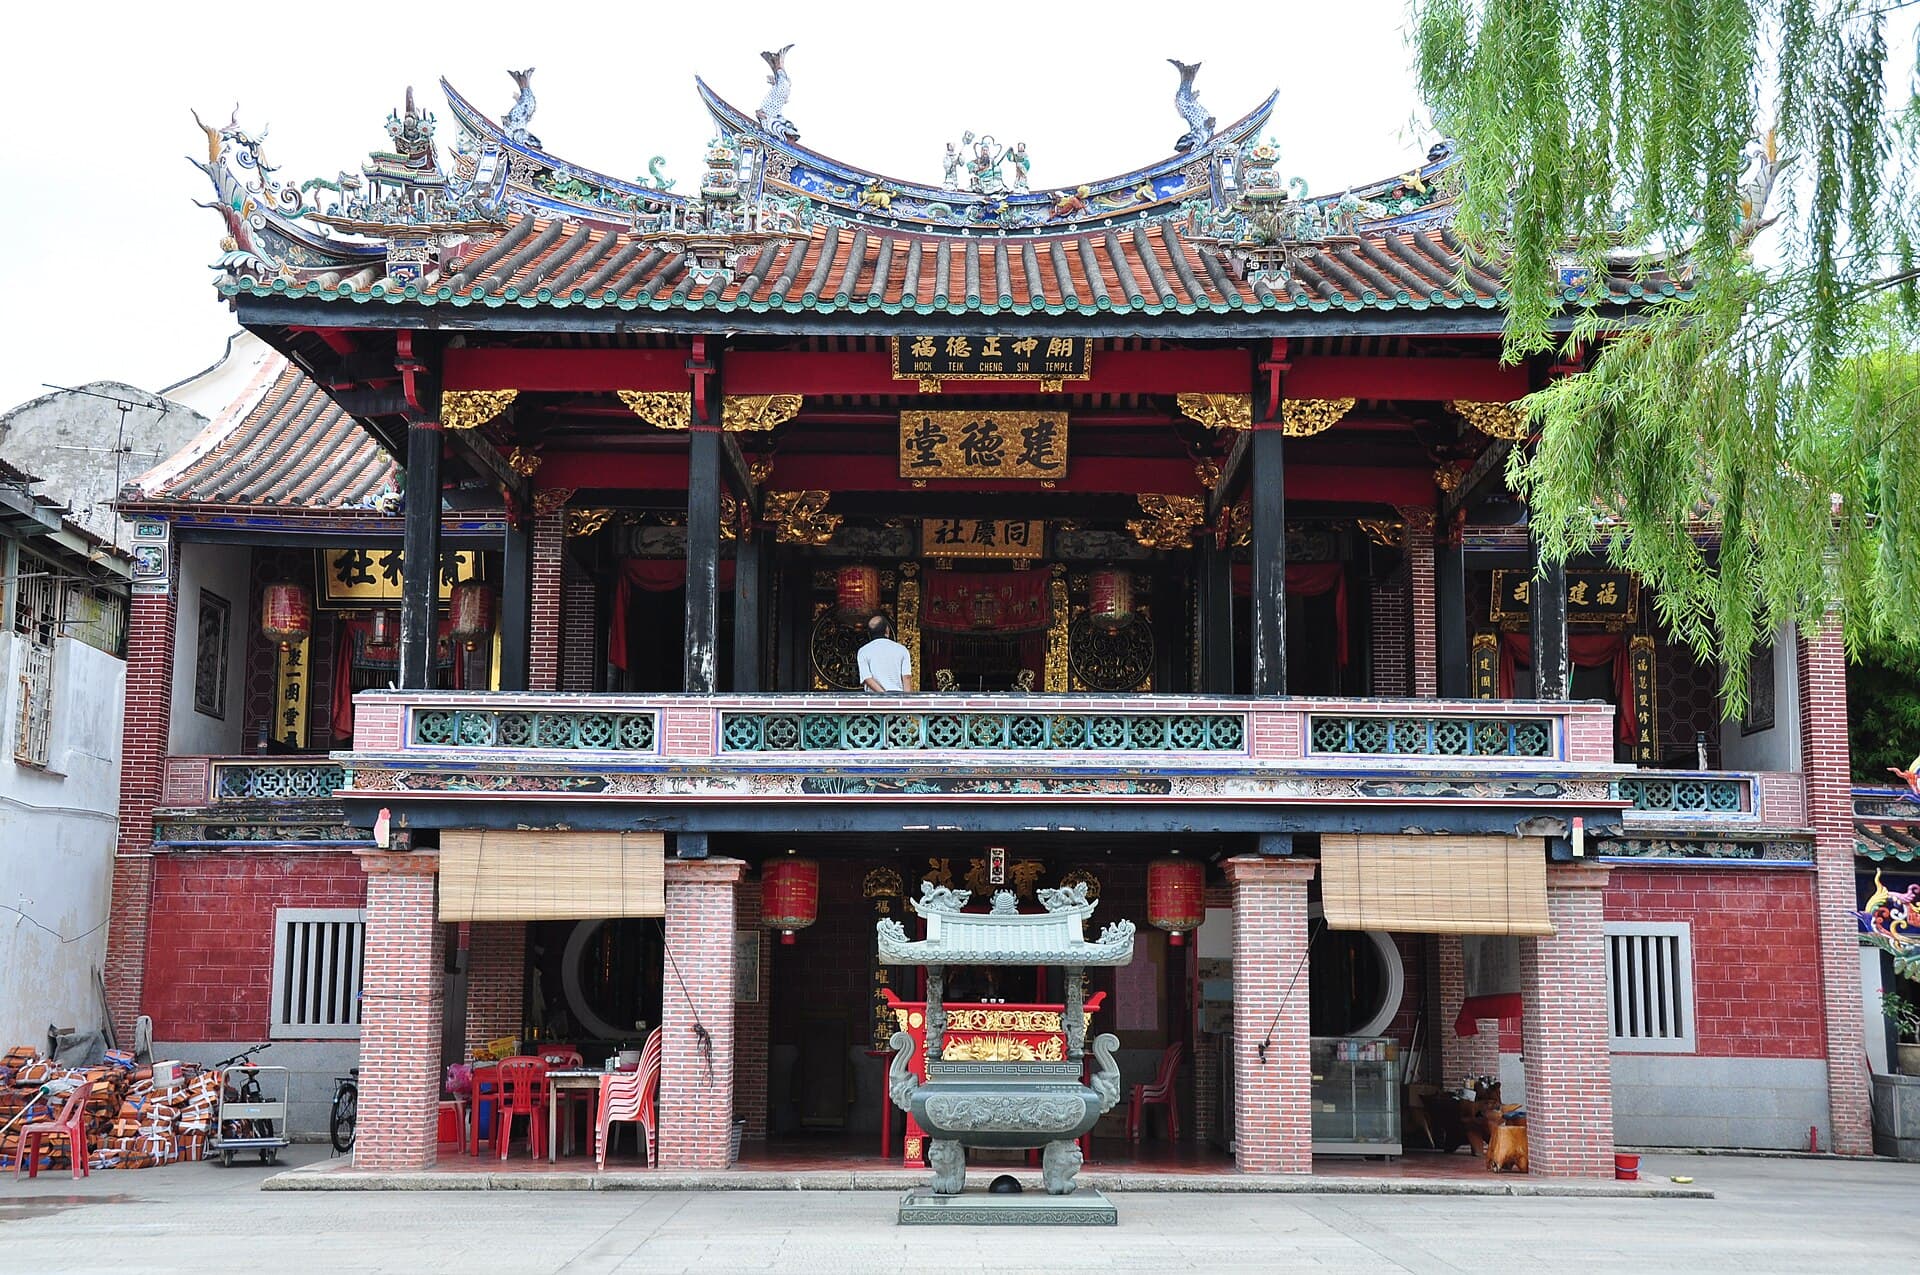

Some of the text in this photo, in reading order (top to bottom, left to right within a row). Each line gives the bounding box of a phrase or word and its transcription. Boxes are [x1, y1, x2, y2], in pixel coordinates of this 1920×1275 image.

[911, 336, 1073, 359] 福德正神廟
[914, 361, 1073, 372] HOCK TEIK CHENG SIN TEMPLE
